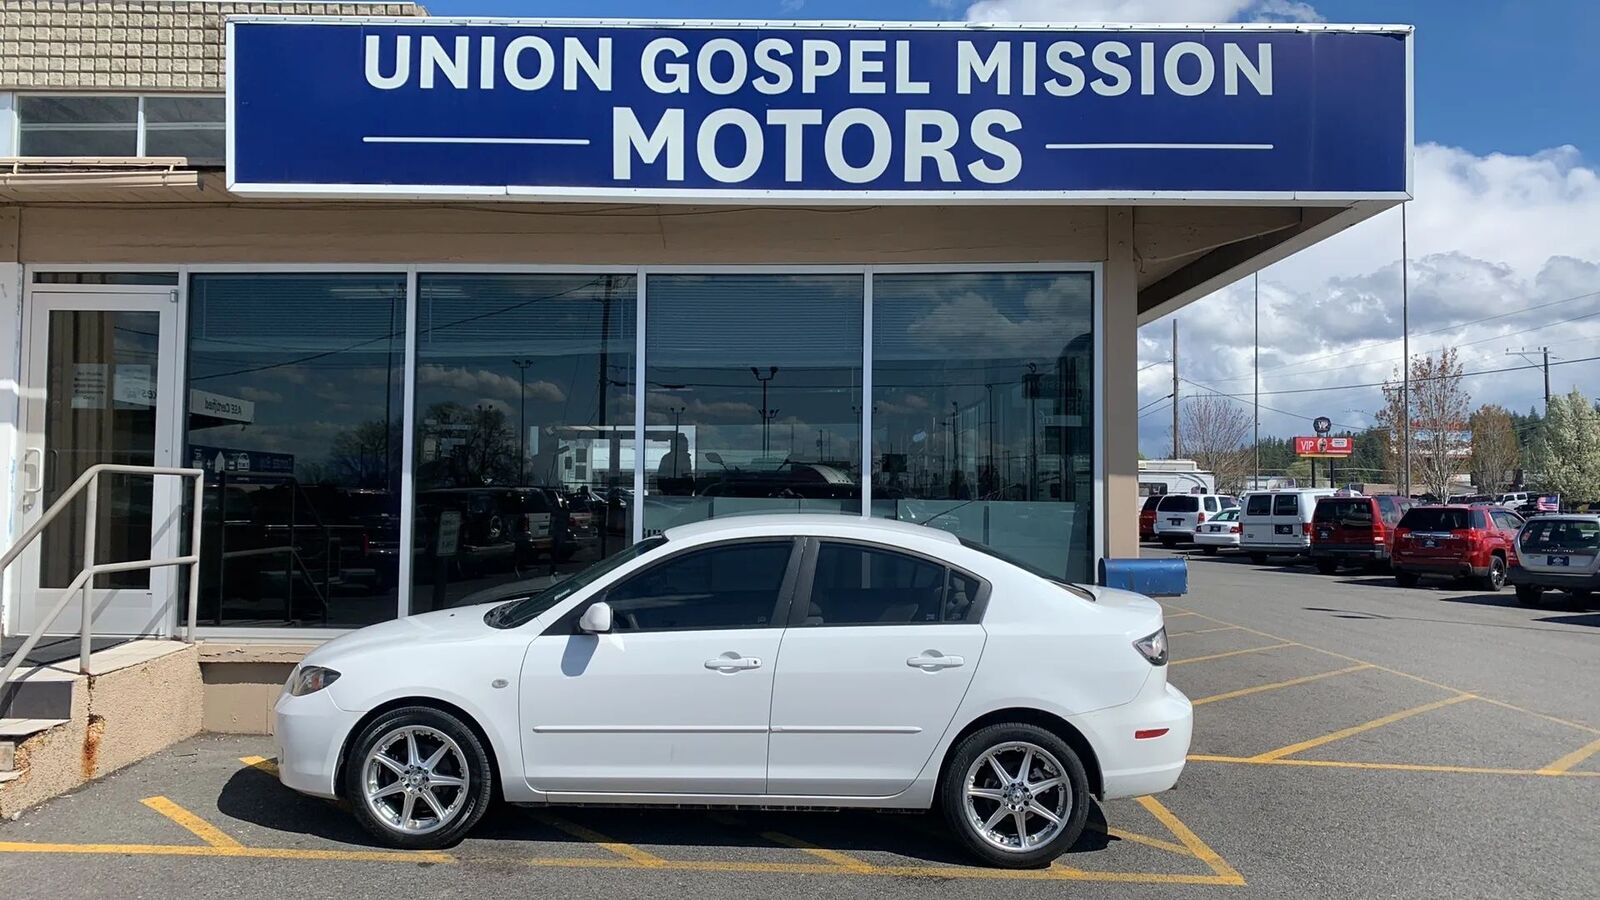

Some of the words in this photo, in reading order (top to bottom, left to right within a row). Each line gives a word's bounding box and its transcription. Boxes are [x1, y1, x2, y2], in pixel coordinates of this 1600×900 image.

[365, 35, 613, 93] UNION
[640, 37, 930, 97] GOSPEL
[957, 40, 1273, 98] MISSION
[612, 106, 1023, 185] MOTORS
[1300, 439, 1315, 452] VIP
